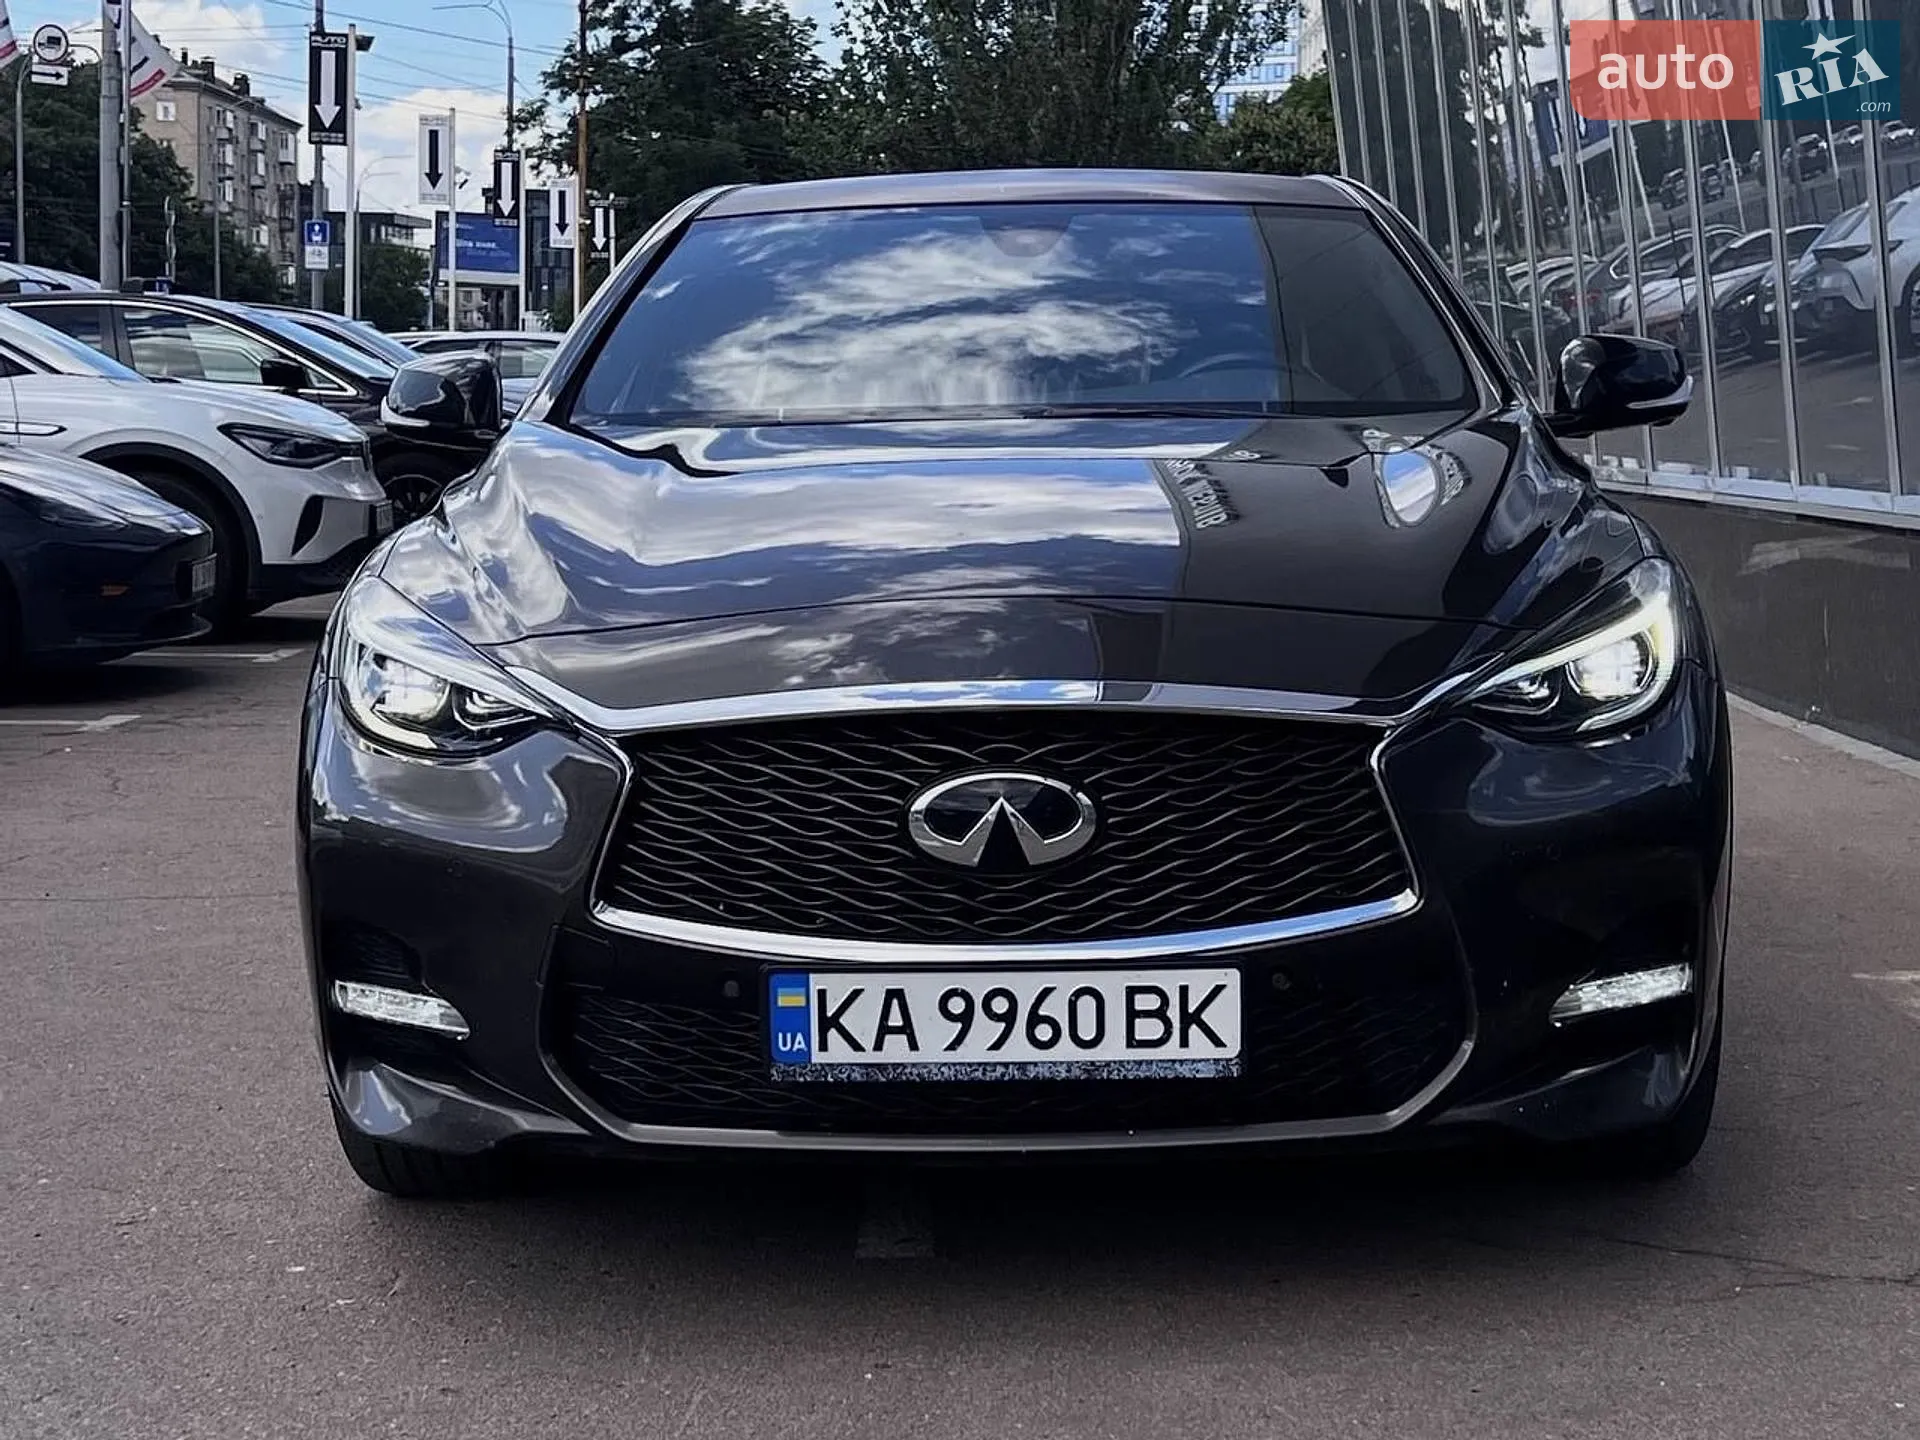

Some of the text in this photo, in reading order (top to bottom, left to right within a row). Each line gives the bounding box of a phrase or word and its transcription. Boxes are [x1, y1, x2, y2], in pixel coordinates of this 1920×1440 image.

[815, 983, 1228, 1053] KA 9960 BK
[778, 1032, 808, 1052] UA
